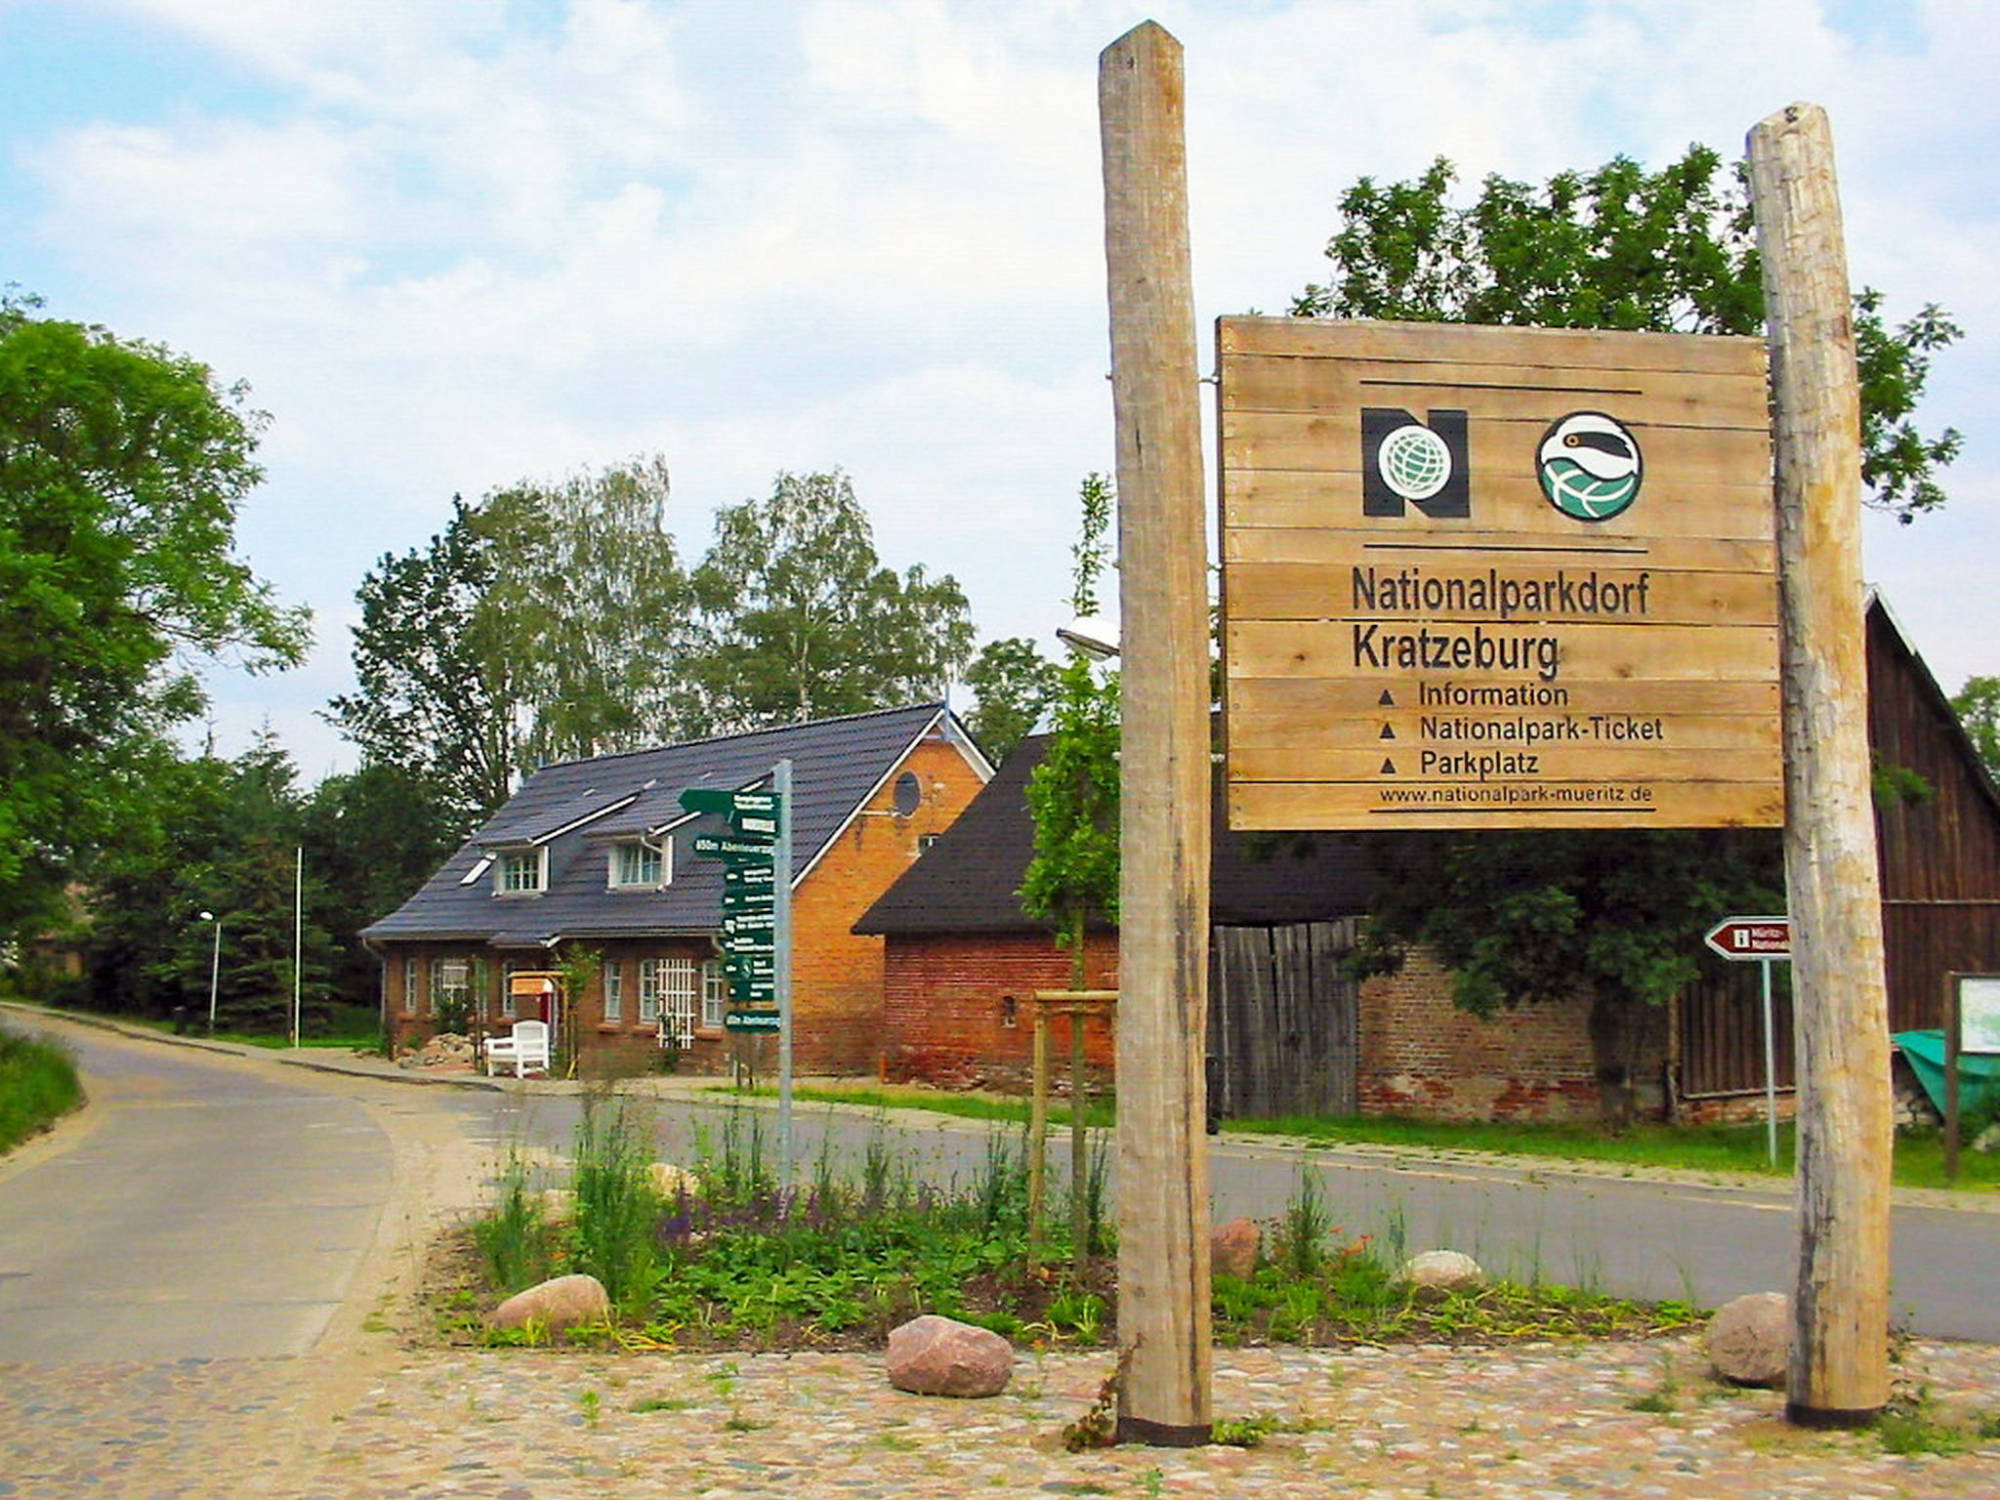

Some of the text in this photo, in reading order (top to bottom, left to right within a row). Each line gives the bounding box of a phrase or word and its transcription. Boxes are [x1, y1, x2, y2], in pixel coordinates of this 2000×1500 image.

[1351, 566, 1650, 619] Nationalparkdorf
[1352, 623, 1559, 682] Kratzeburg
[1418, 681, 1569, 706] Information
[1419, 716, 1664, 745] Nationalpark-Ticket
[1419, 750, 1539, 782] Parkplatz
[1379, 785, 1653, 806] www.nationalpark-mueritz.de
